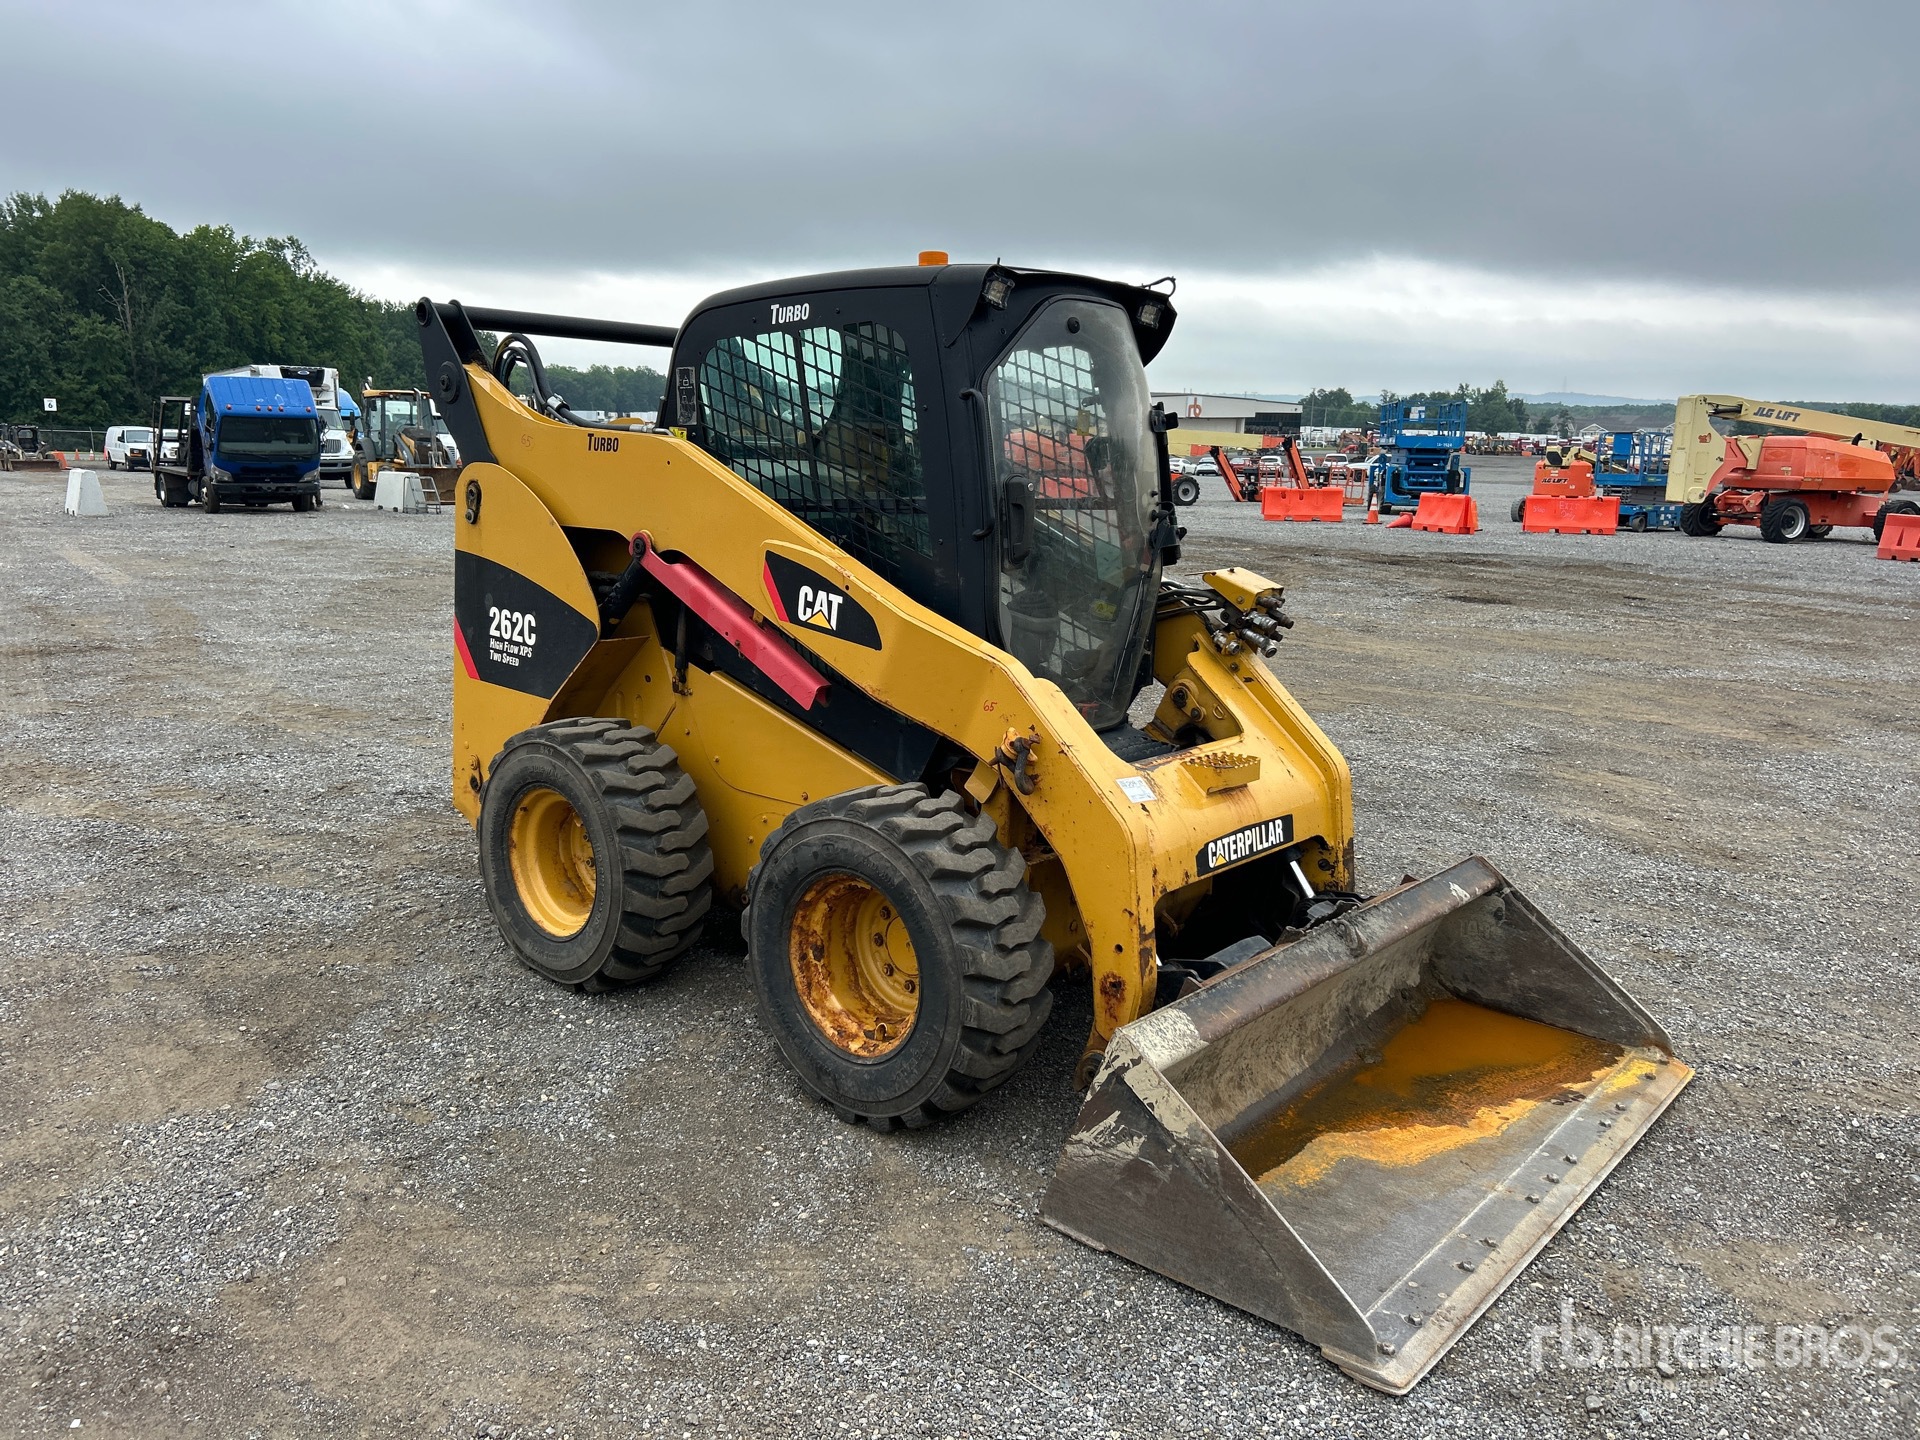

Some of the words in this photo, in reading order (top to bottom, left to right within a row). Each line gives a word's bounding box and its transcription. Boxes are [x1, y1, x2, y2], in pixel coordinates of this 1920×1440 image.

[770, 303, 810, 325] TURBO
[1753, 406, 1776, 418] JLG
[1775, 410, 1801, 422] LIFT
[586, 432, 620, 453] TURBO
[797, 585, 843, 631] CAT
[489, 606, 536, 646] 262C
[519, 644, 533, 658] XPS
[983, 699, 998, 712] 65
[1207, 818, 1284, 869] CATERPILLAR
